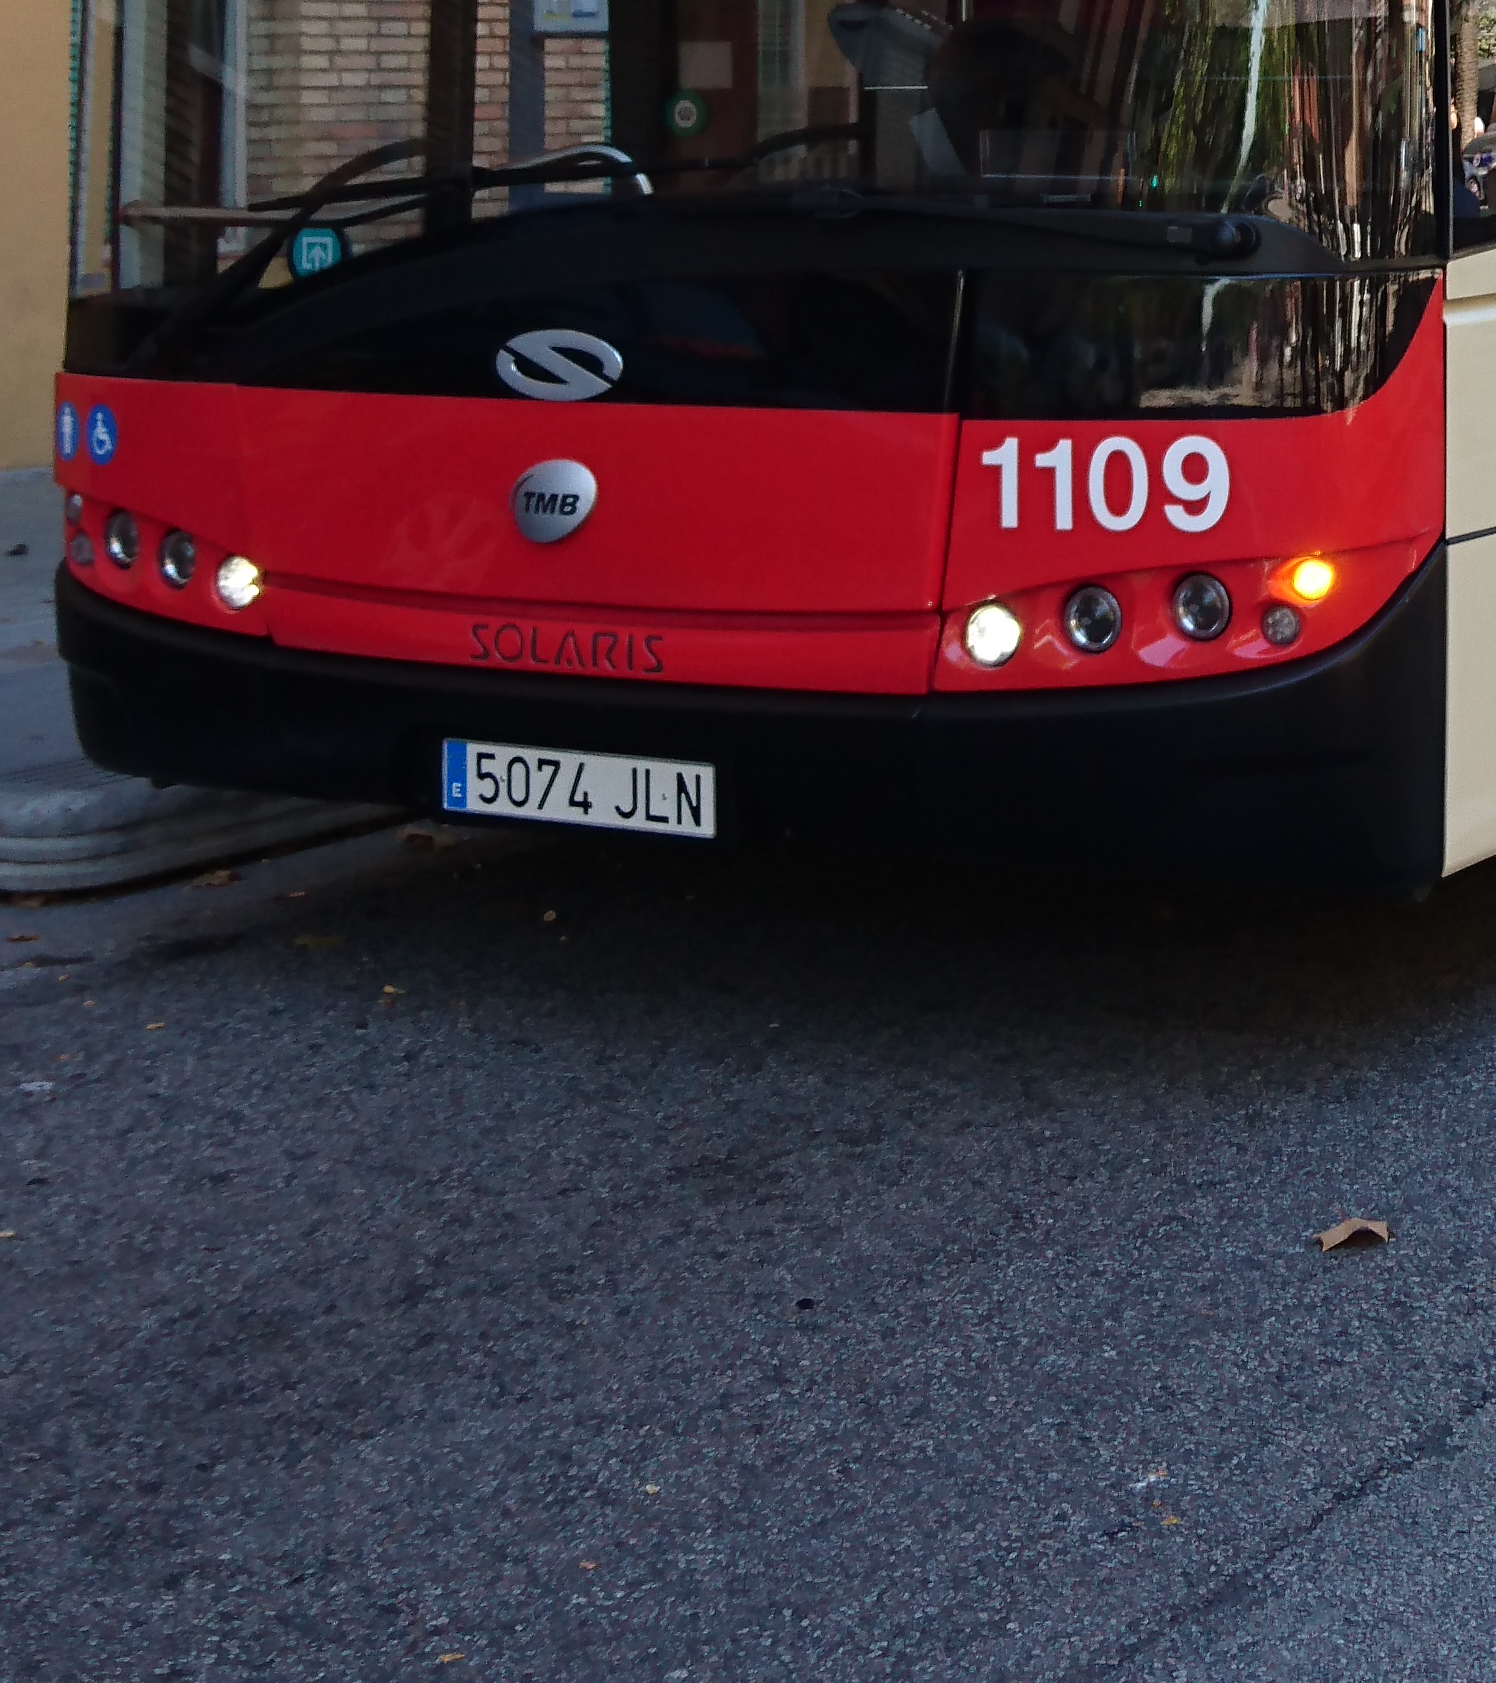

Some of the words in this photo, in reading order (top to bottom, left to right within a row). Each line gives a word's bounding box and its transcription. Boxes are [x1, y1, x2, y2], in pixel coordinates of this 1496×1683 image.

[524, 492, 580, 516] TMB
[980, 434, 1232, 534] 1109
[470, 622, 664, 674] SOLARIS
[452, 783, 462, 798] E
[476, 752, 592, 816] 5074
[614, 767, 702, 828] JLN
